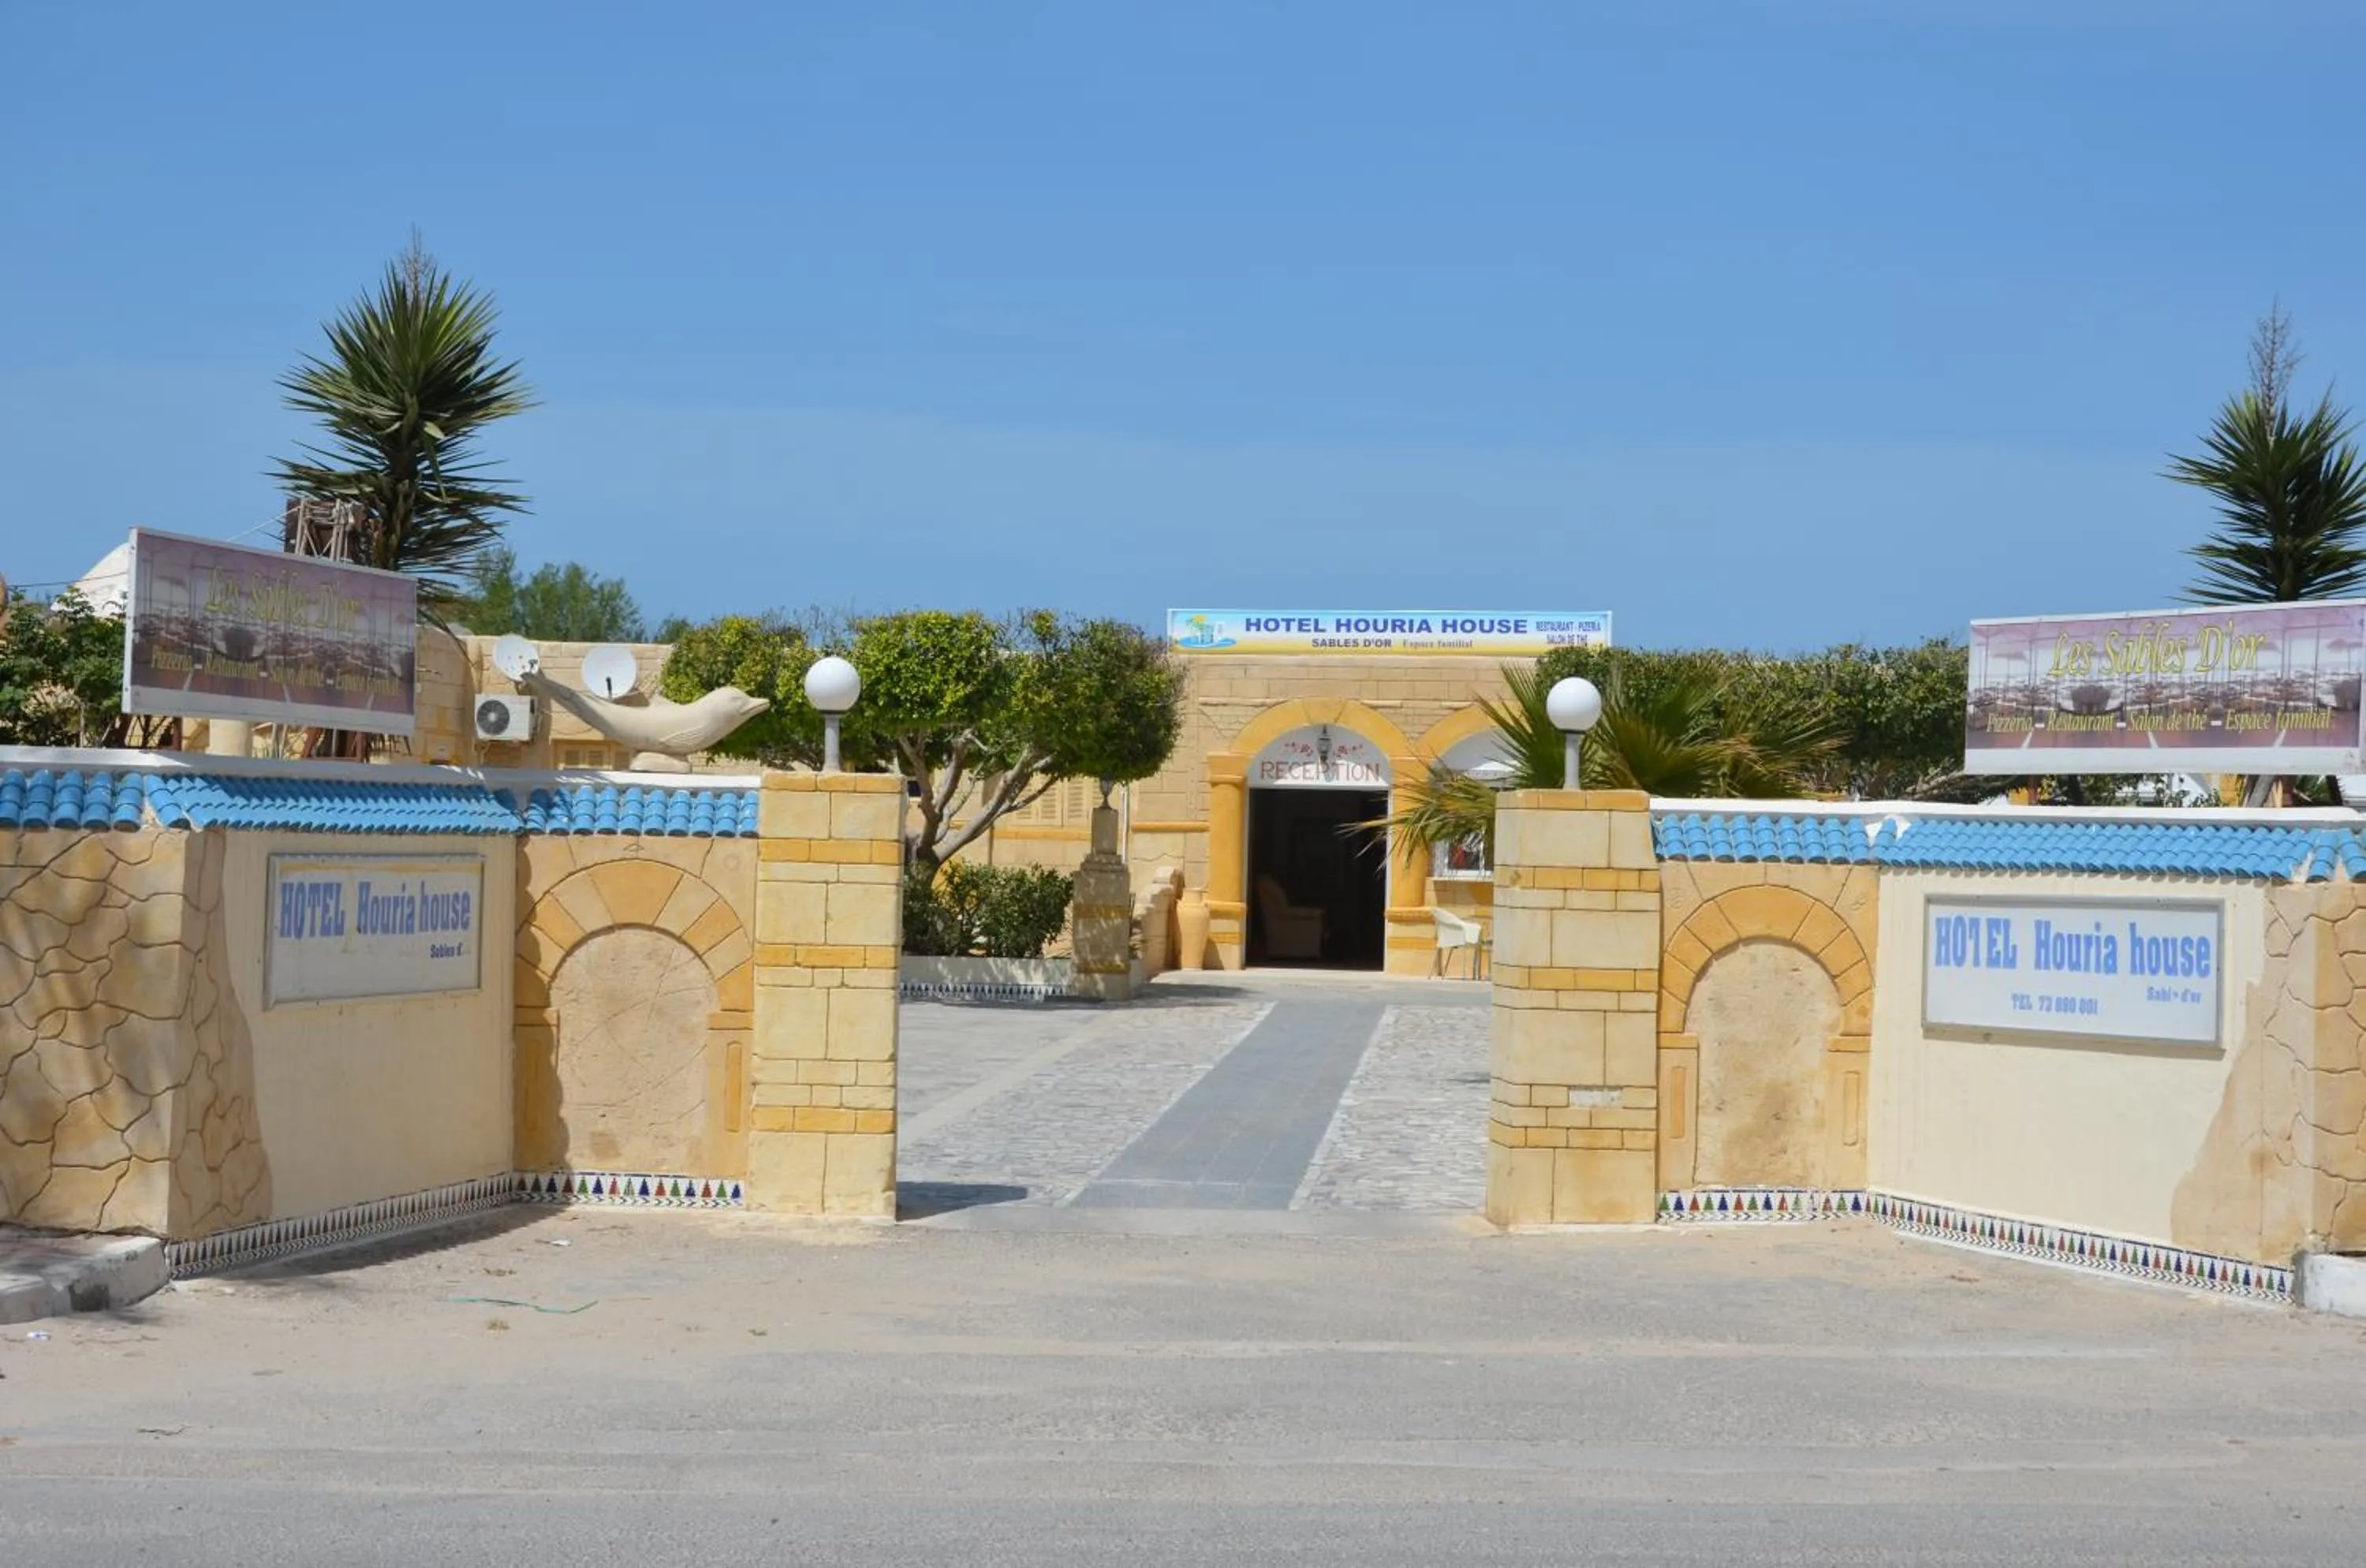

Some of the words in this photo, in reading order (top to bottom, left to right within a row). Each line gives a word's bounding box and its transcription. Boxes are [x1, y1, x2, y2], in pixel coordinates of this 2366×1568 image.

[1245, 618, 1327, 633] HOTEL
[1335, 618, 1433, 634] HOURIA
[1441, 619, 1528, 634] HOUSE
[1312, 639, 1359, 648] SABLES
[1364, 639, 1392, 648] D'OR
[2048, 632, 2092, 678] Les
[2099, 622, 2187, 676] Sables
[2196, 620, 2267, 673] D'or
[1987, 712, 2034, 733] Pizzeria
[2047, 712, 2116, 733] Restaurant
[2128, 710, 2163, 731] Salon
[2167, 710, 2181, 730] de
[2225, 709, 2271, 733] Espace
[2275, 706, 2332, 731] familial
[1260, 760, 1380, 782] RECEPTION
[279, 881, 345, 939] HOTEL
[356, 881, 416, 935] Houria
[419, 881, 471, 932] house
[1935, 915, 2017, 970] HOTEL
[2034, 919, 2118, 975] Houria
[2130, 922, 2211, 978] house
[2012, 992, 2033, 1010] TEL
[2038, 995, 2052, 1013] 73
